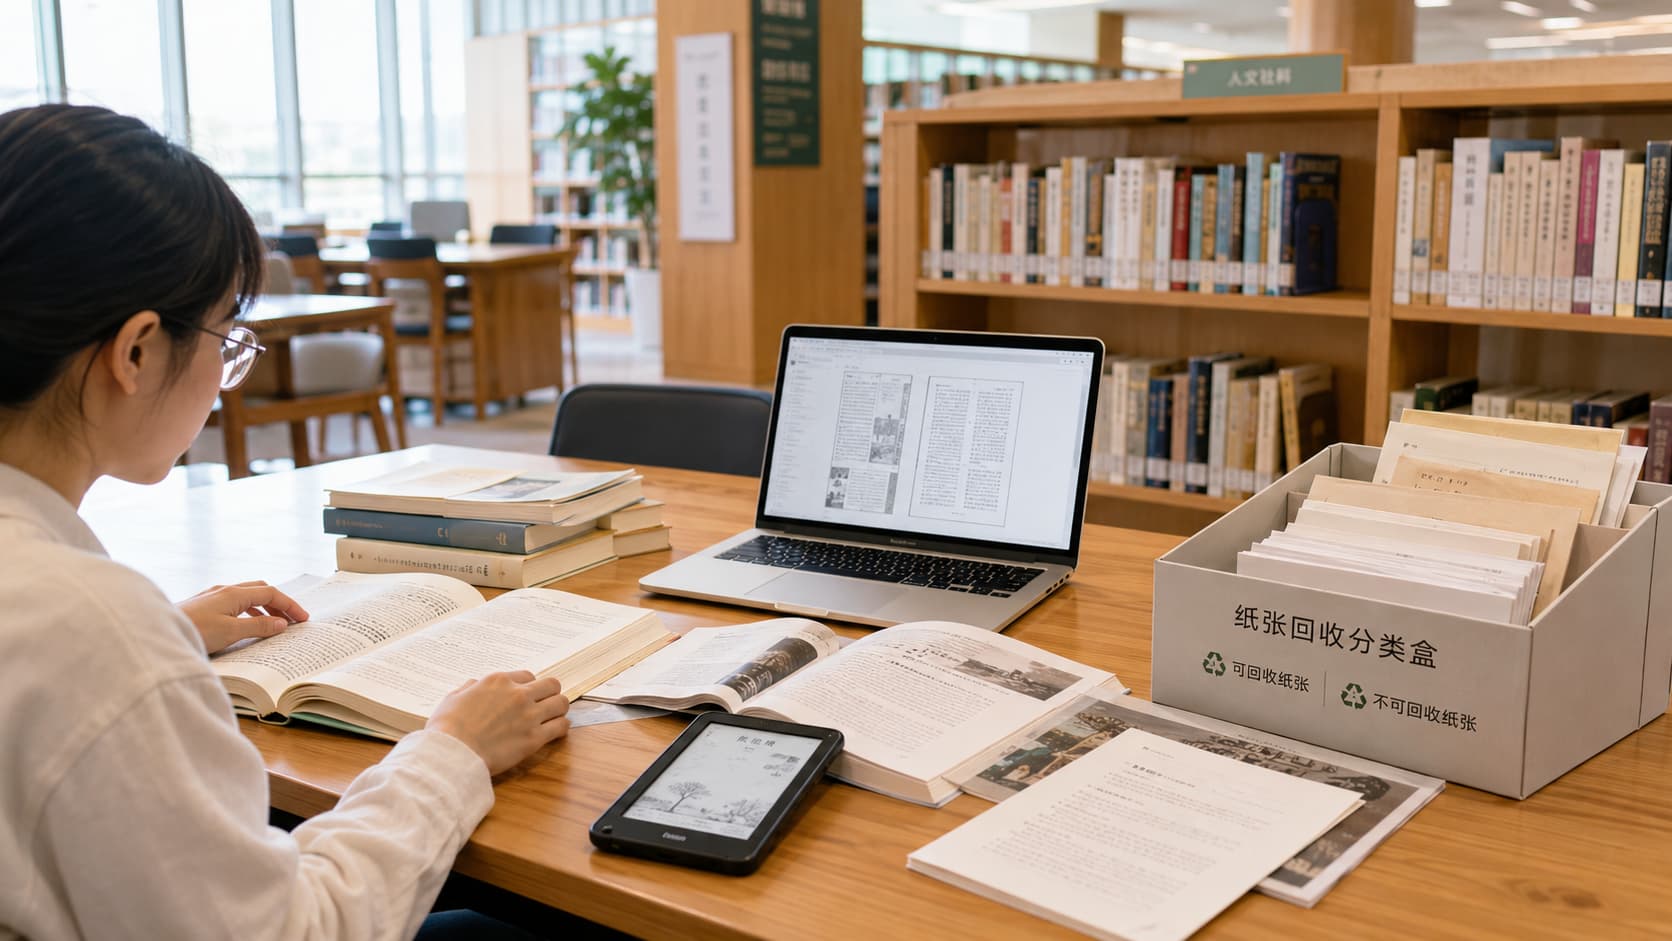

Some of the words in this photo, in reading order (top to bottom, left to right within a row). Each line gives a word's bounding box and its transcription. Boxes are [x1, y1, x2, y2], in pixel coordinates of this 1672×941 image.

[1234, 604, 1438, 669] 纸张回收分类盒
[1232, 661, 1310, 692] 可回收纸张
[1373, 693, 1478, 733] 不可回收纸张
